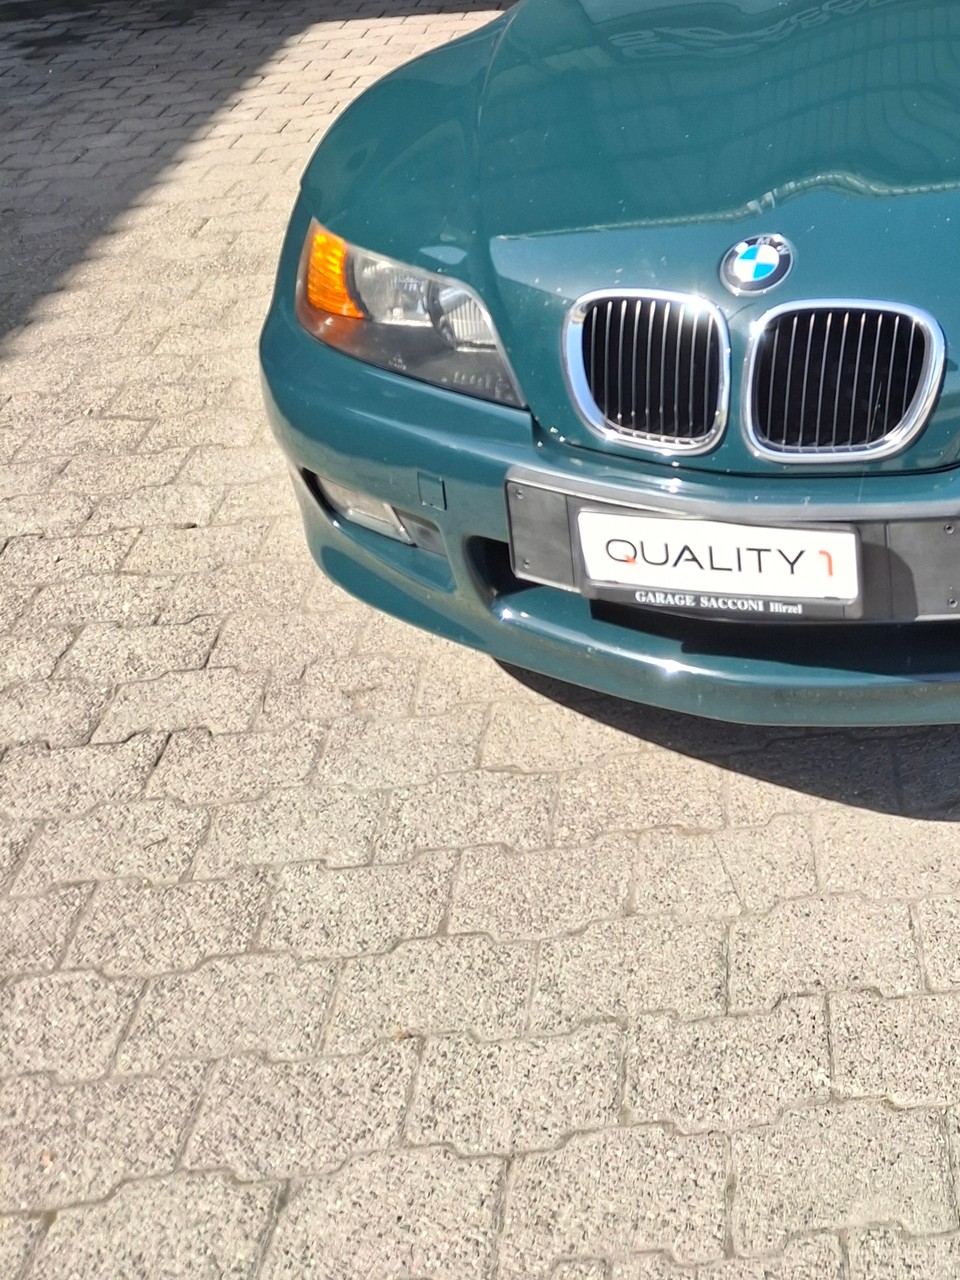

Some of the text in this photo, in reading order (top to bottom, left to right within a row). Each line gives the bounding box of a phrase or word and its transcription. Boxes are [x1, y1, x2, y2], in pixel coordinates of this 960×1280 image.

[605, 538, 805, 575] QUALITY
[635, 590, 803, 615] GARAGE SACCONI Hirzel
